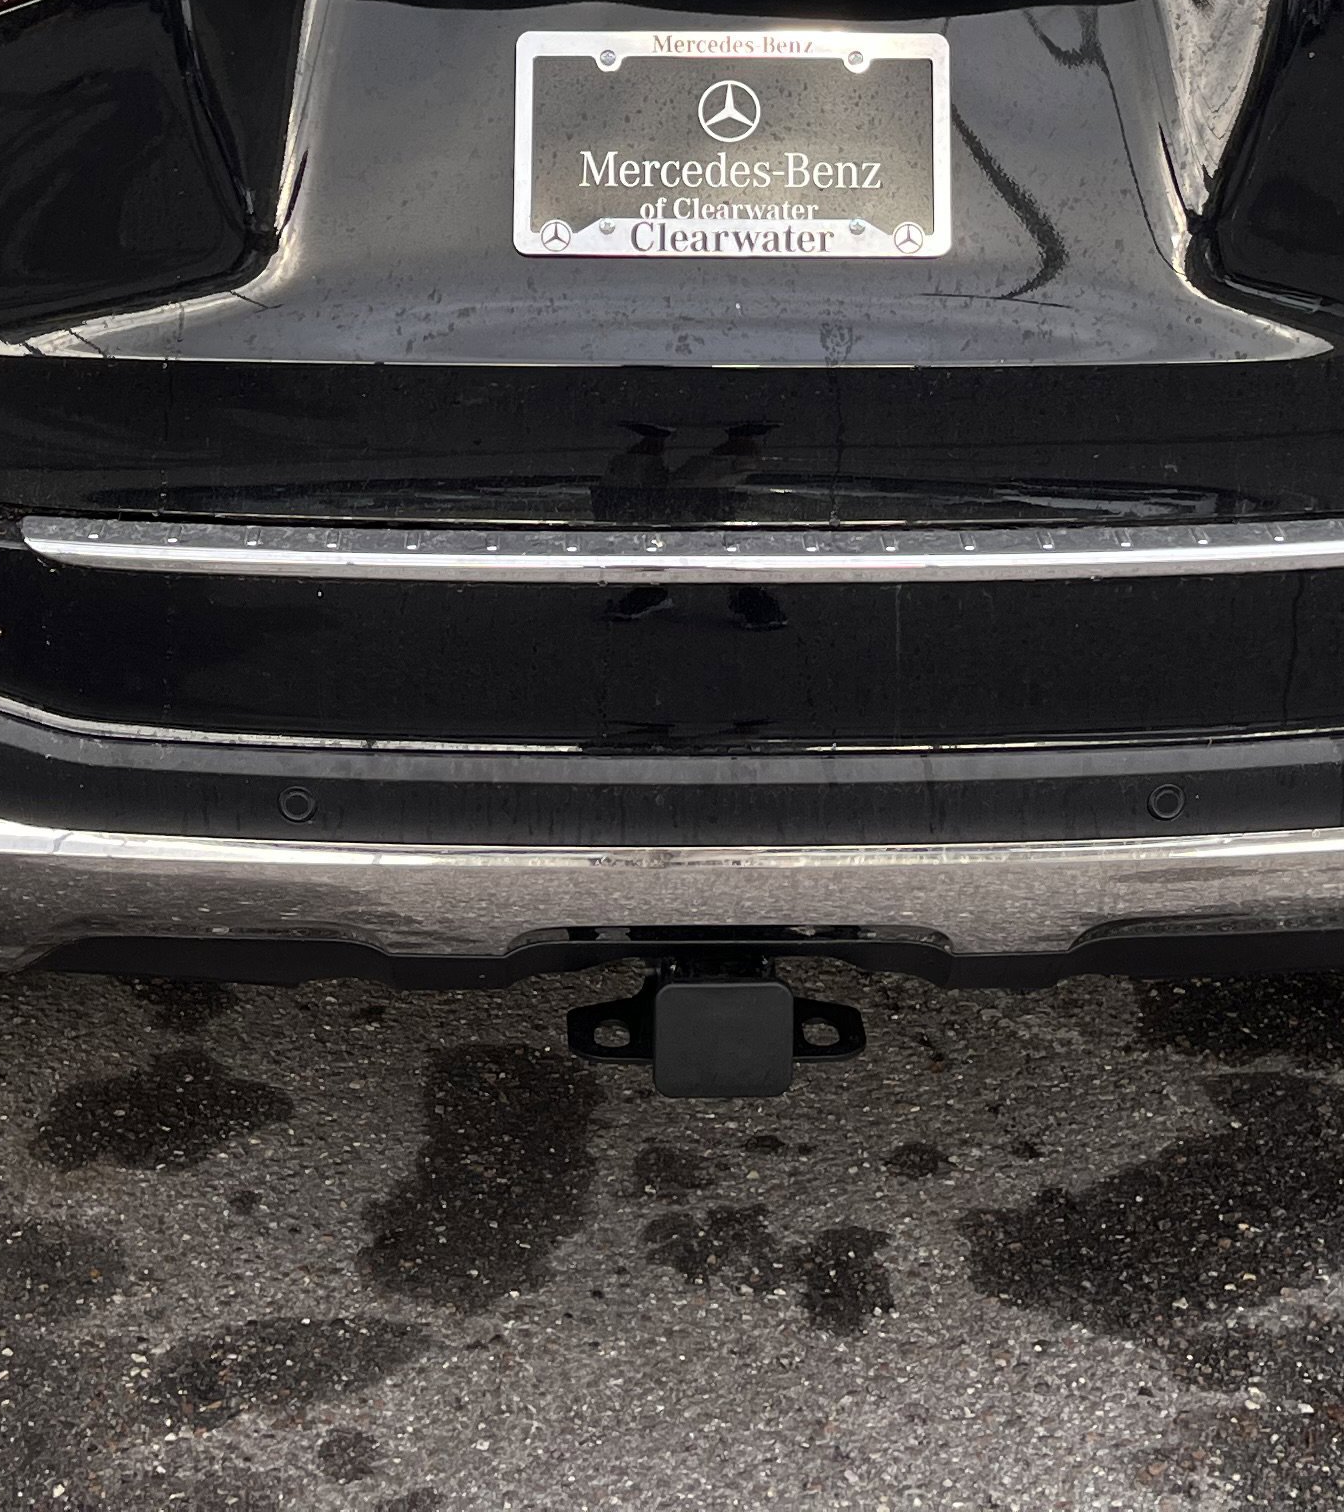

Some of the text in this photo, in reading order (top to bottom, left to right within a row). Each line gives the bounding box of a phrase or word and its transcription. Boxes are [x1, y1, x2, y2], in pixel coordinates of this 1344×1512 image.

[652, 34, 815, 55] Mercedes-Benz
[578, 150, 882, 189] Mercedes-Benz
[639, 196, 819, 220] of Clearwater
[630, 221, 835, 254] Clearwater
